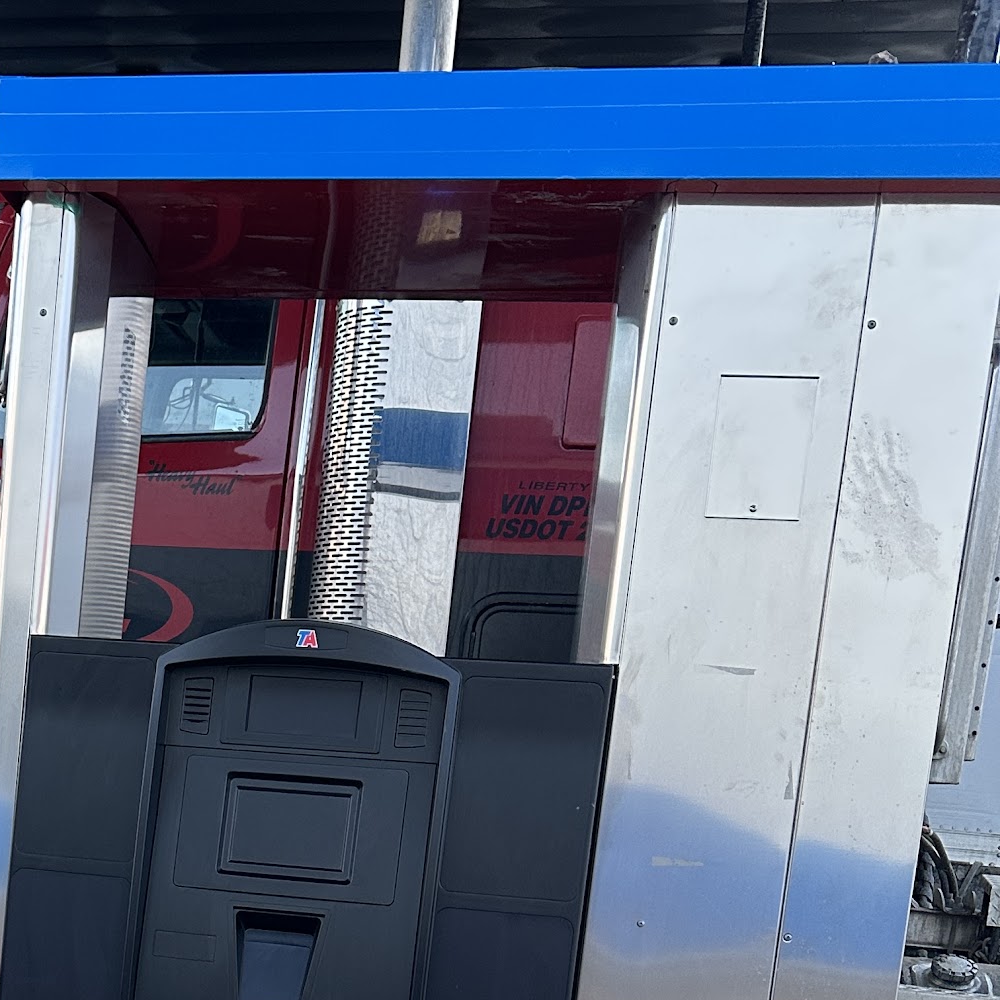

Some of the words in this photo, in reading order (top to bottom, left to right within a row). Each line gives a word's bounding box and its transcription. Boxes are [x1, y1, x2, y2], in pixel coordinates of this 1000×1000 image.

[518, 480, 590, 492] LIBERTY
[501, 494, 546, 516] VIN
[485, 518, 574, 541] USDOT
[295, 628, 319, 649] TA
